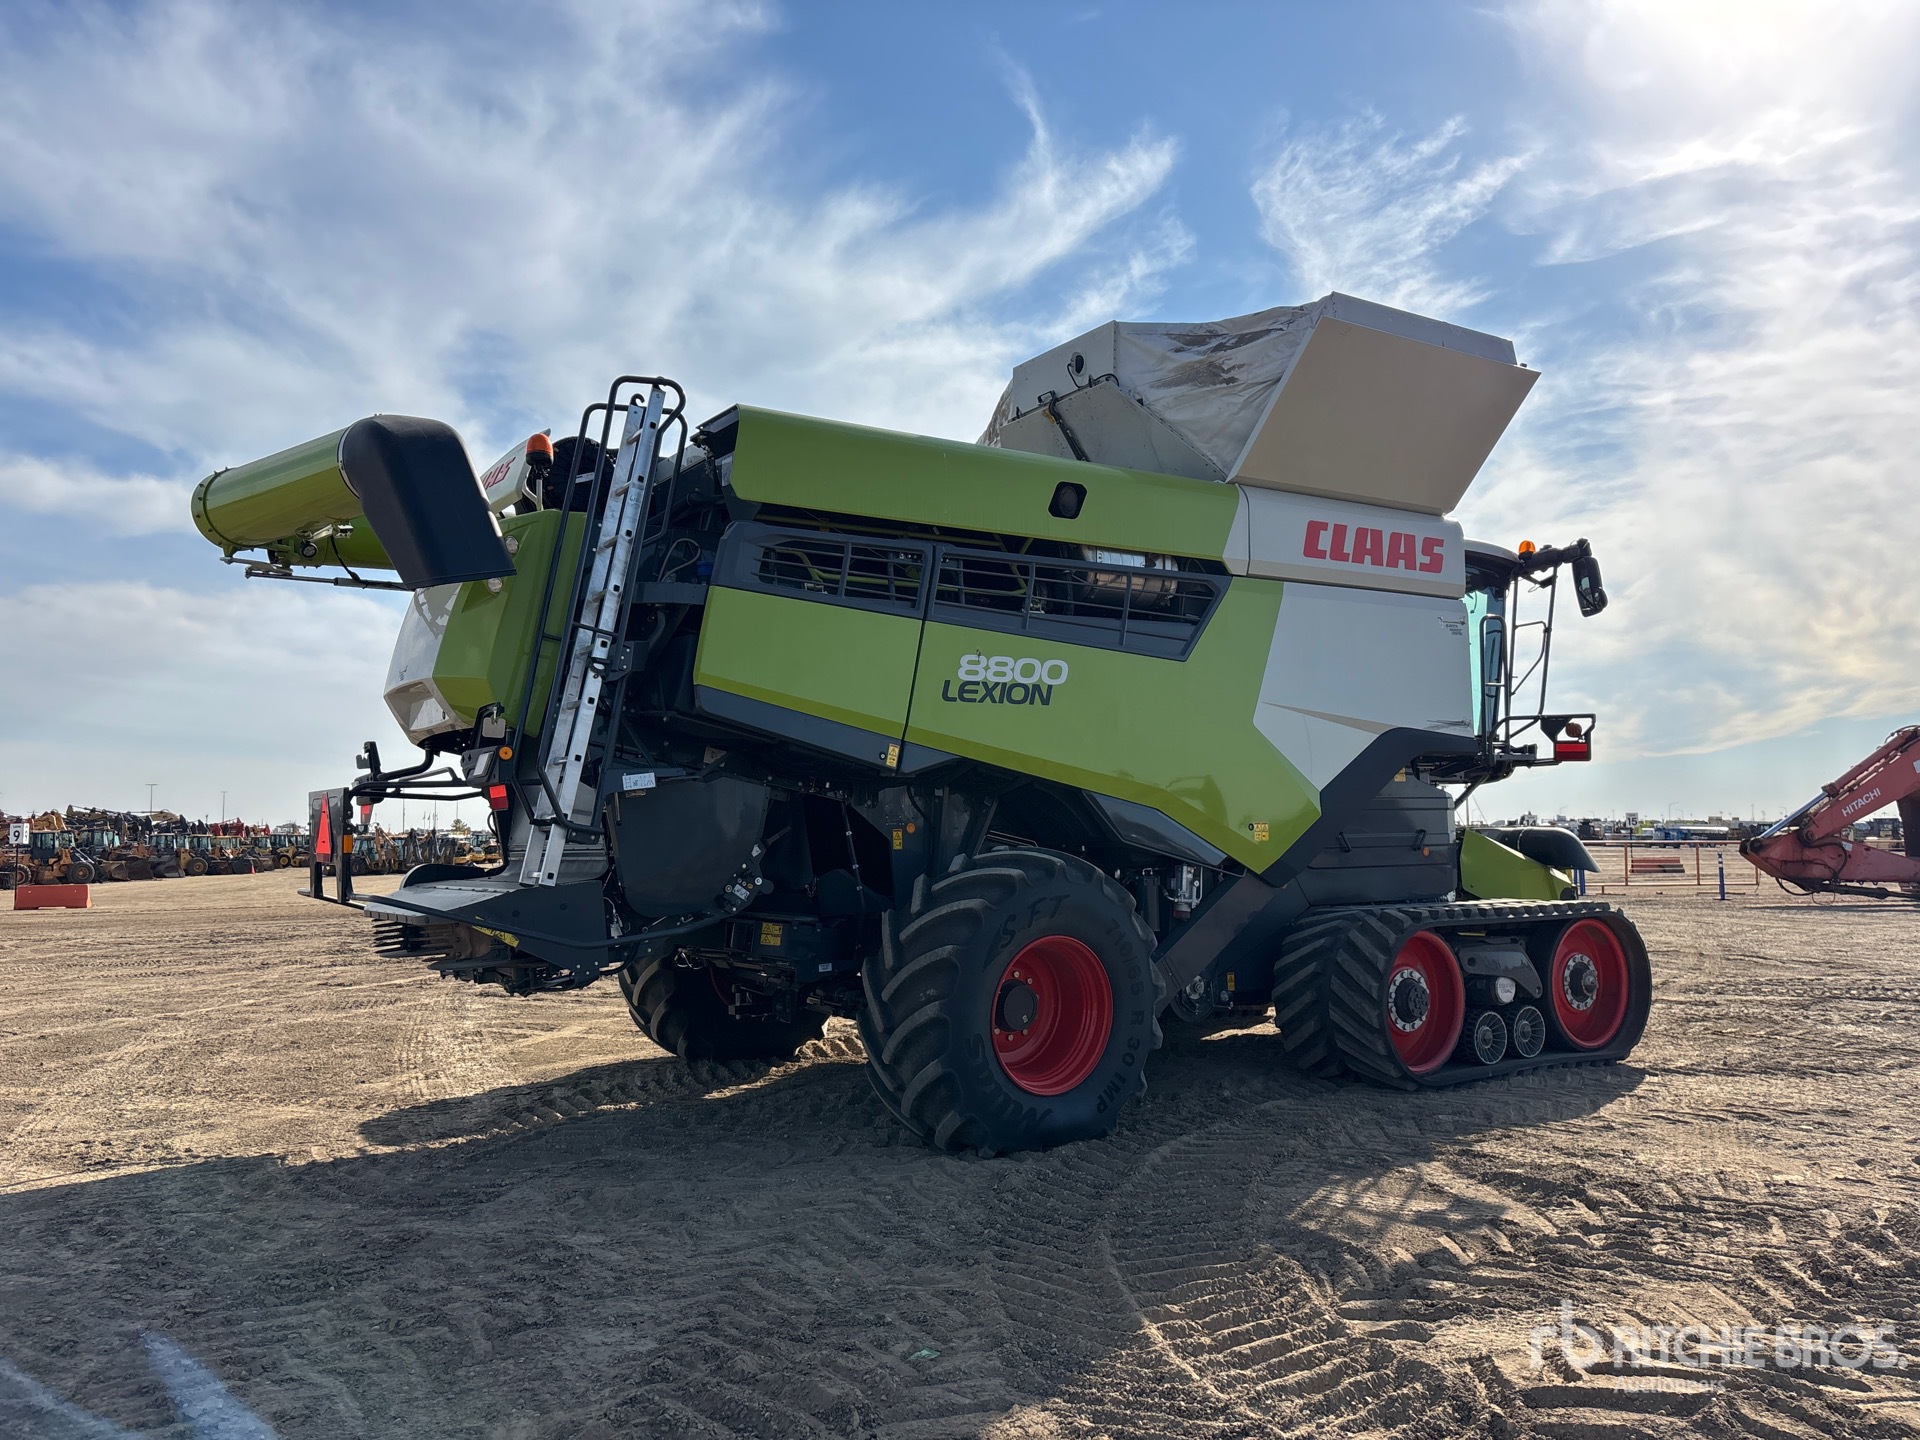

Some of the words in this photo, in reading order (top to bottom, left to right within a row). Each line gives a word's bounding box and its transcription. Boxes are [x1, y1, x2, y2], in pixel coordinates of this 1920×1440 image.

[1303, 519, 1445, 574] CLAAS
[957, 654, 1069, 685] 8800
[941, 679, 1053, 706] LEXION
[1841, 787, 1881, 817] HITACHI
[13, 830, 20, 841] 9
[1627, 817, 1638, 826] 15
